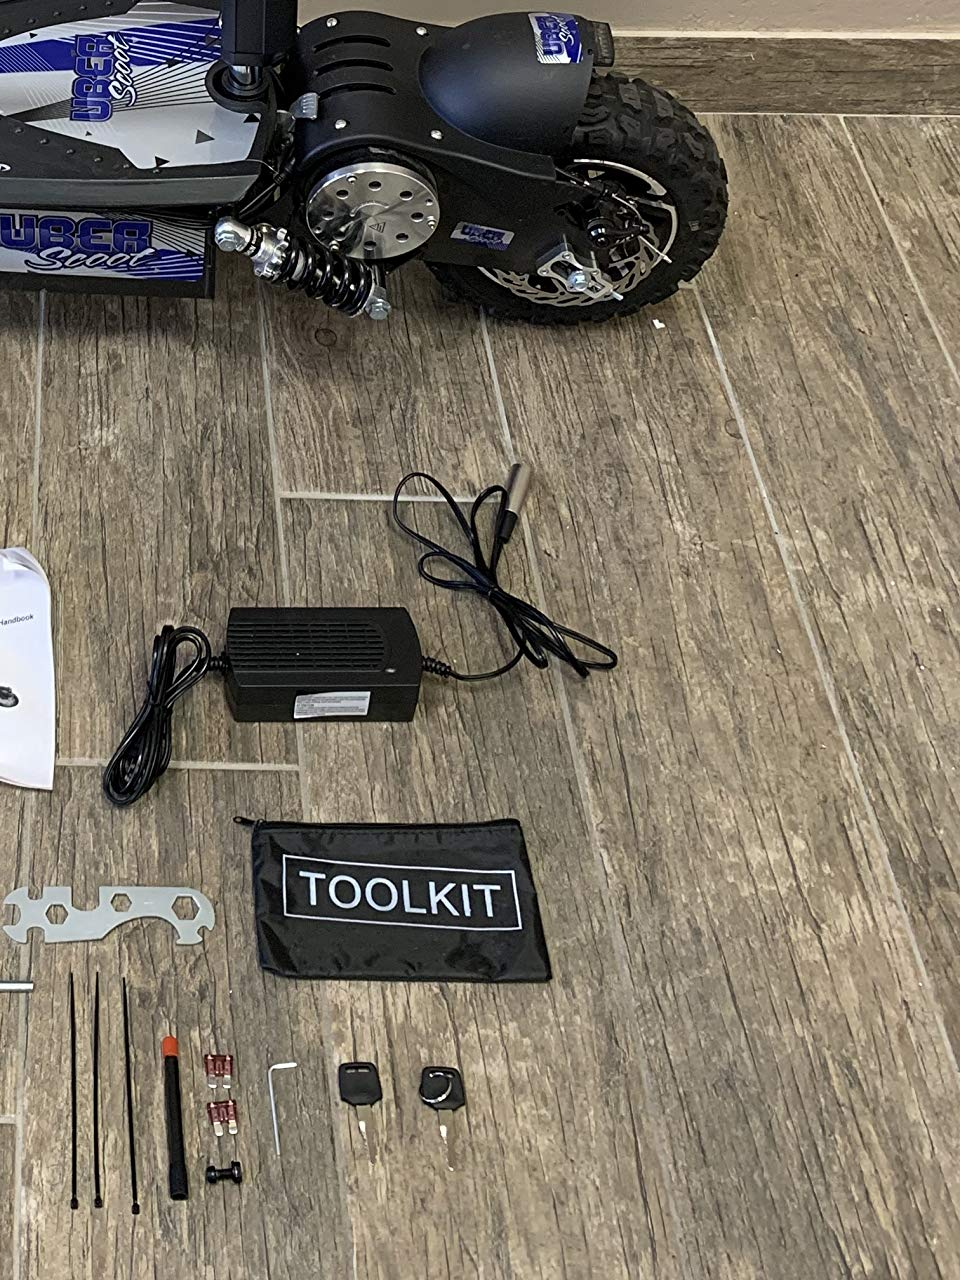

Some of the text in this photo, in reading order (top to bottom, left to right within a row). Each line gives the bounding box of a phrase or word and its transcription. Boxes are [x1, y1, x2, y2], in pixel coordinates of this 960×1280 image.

[70, 34, 114, 122] UBER
[106, 32, 137, 108] Scoot
[24, 246, 157, 270] Scoot
[298, 870, 502, 918] TOOLKIT
